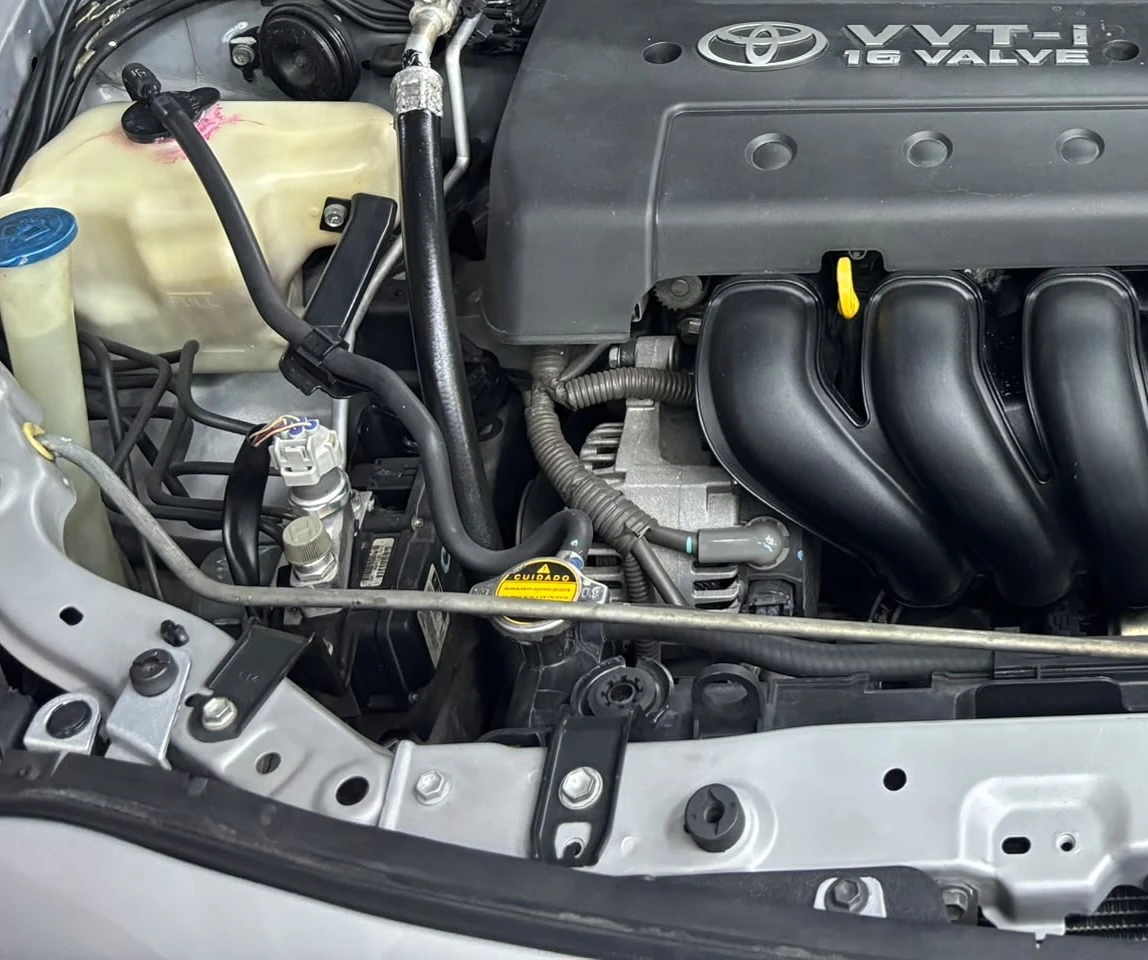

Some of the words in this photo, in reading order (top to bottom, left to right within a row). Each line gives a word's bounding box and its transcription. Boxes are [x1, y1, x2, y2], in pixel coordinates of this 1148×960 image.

[843, 49, 901, 67] 16
[913, 49, 1091, 67] VALVE
[514, 573, 570, 582] CUIDADO
